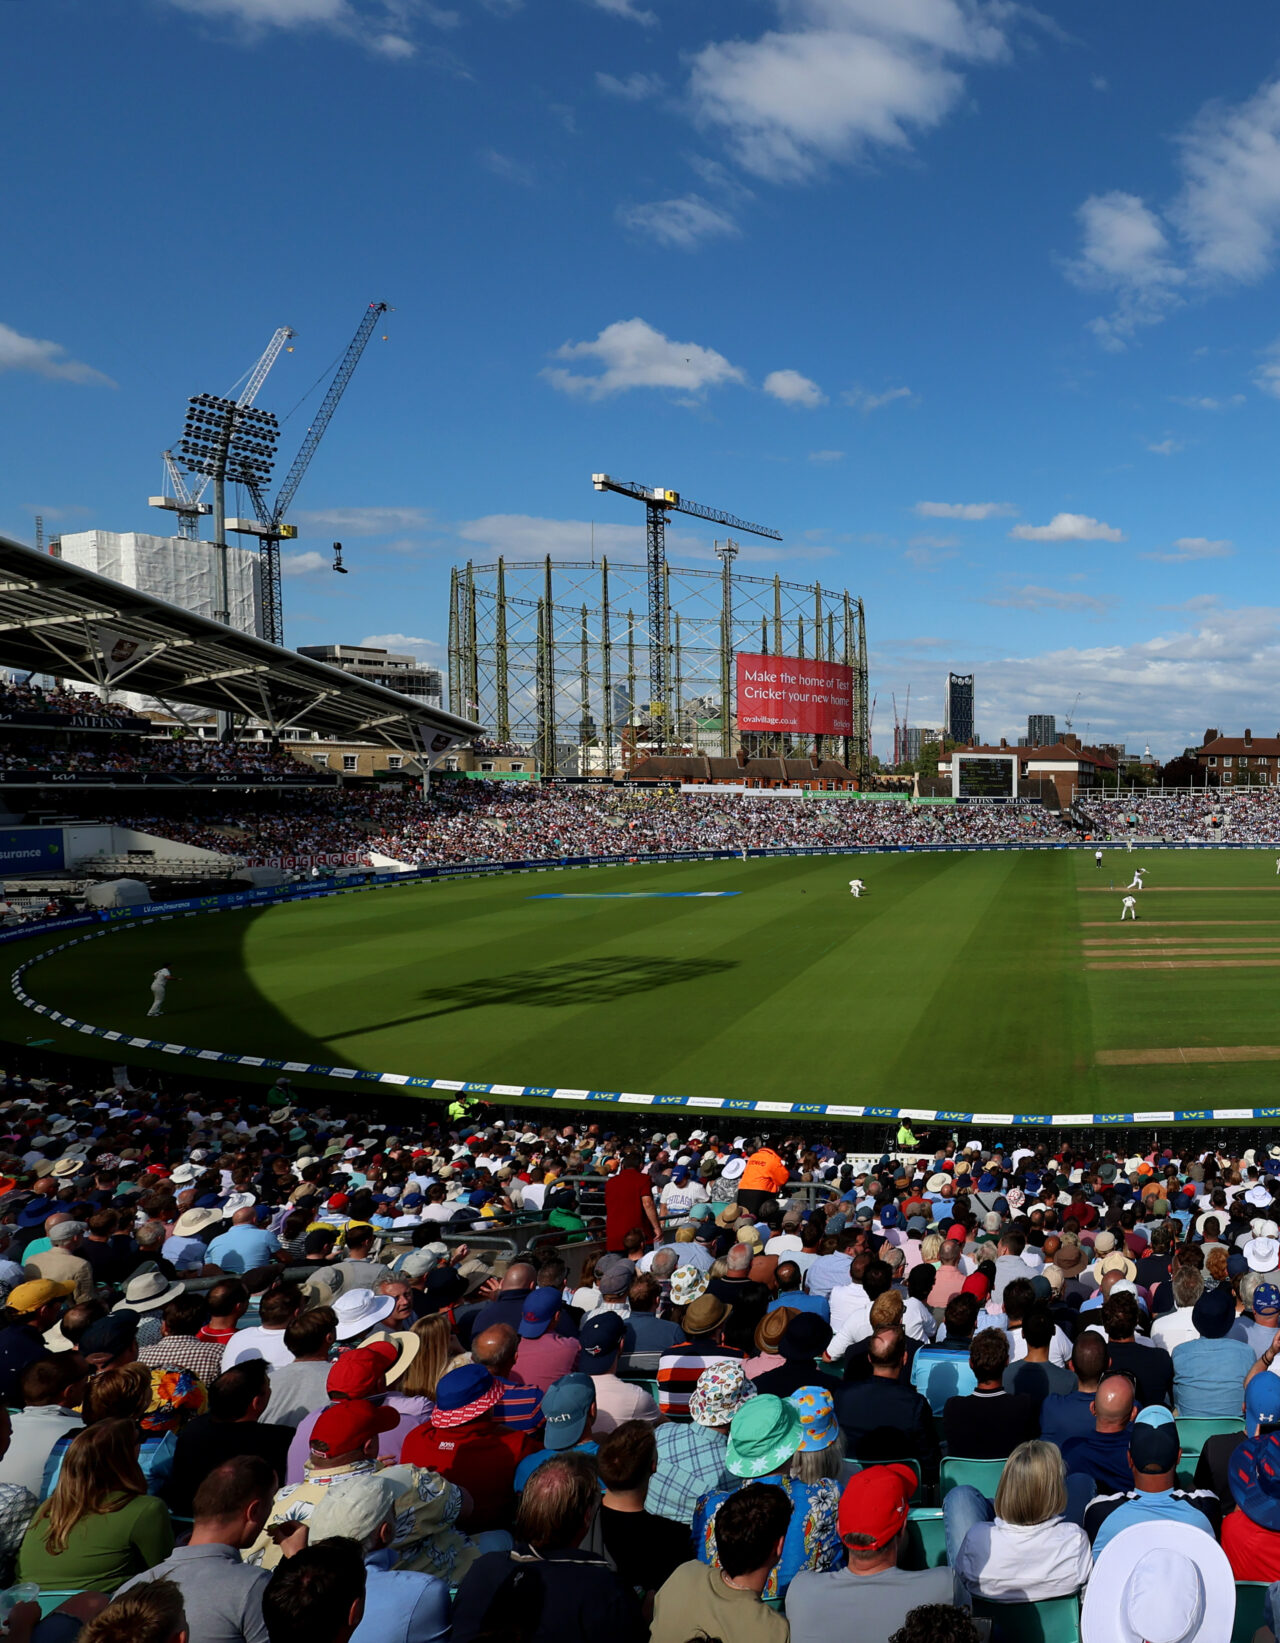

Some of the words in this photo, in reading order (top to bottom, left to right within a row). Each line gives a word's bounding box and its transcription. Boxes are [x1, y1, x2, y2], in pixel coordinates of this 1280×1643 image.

[744, 670, 778, 683] Make
[780, 673, 796, 685] the
[799, 674, 825, 687] home
[826, 679, 834, 689] of
[836, 679, 850, 691] Test
[744, 687, 786, 700] Cricket
[788, 692, 810, 703] your
[812, 695, 828, 704] new
[831, 695, 850, 707] home
[69, 716, 88, 728] JM
[91, 717, 123, 729] FINN
[743, 716, 799, 726] ovalvillage.co.uk
